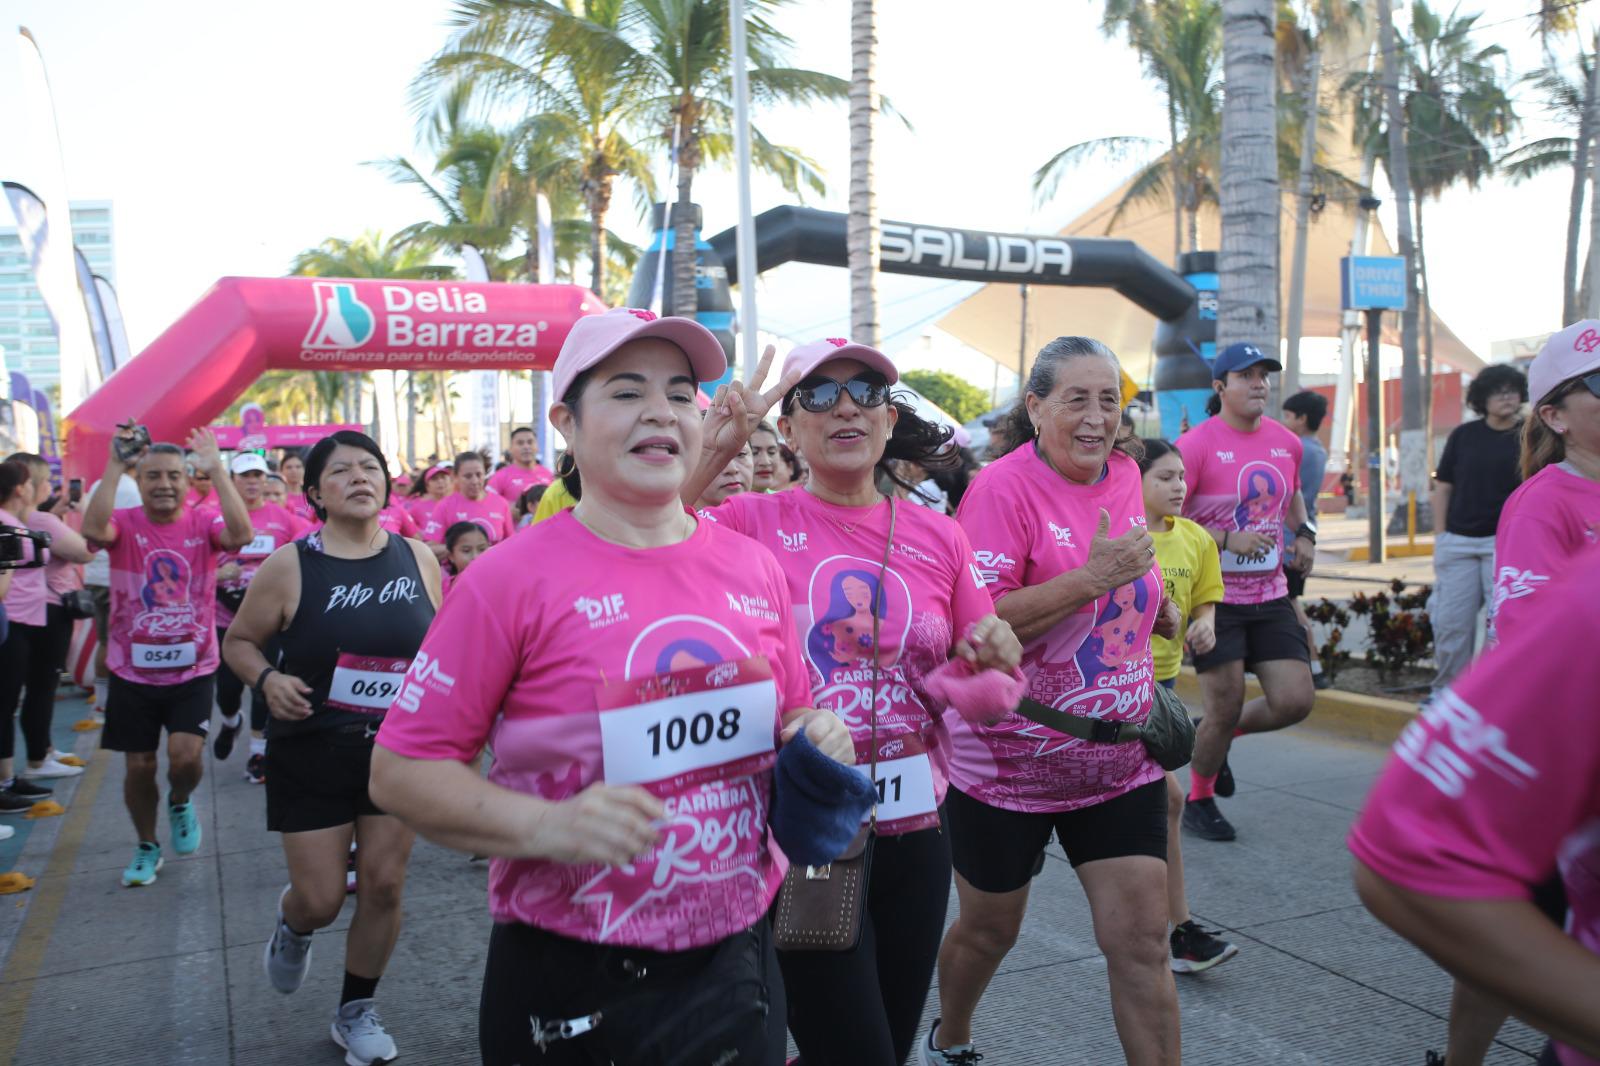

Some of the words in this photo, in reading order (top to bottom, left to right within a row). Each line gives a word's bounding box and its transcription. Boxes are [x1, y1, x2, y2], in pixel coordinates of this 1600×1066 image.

[880, 223, 1073, 275] SALIDA
[1355, 267, 1401, 281] DRIVE
[382, 285, 487, 313] Delia
[1360, 283, 1401, 297] THRU
[299, 350, 385, 362] Confianza
[387, 352, 424, 363] para
[427, 351, 445, 362] tu
[446, 350, 536, 364] diagnóstico
[782, 531, 807, 546] DIF
[973, 550, 1016, 567] RA
[1160, 567, 1192, 579] TISMO
[324, 582, 374, 613] BAD
[378, 576, 420, 604] GIRL
[586, 593, 625, 622] DIF
[144, 650, 182, 662] 0547
[813, 683, 909, 724] Rosa
[646, 708, 741, 757] 1008
[1065, 746, 1117, 759] Centro
[663, 785, 749, 817] CARRERA
[650, 807, 752, 887] Rosa
